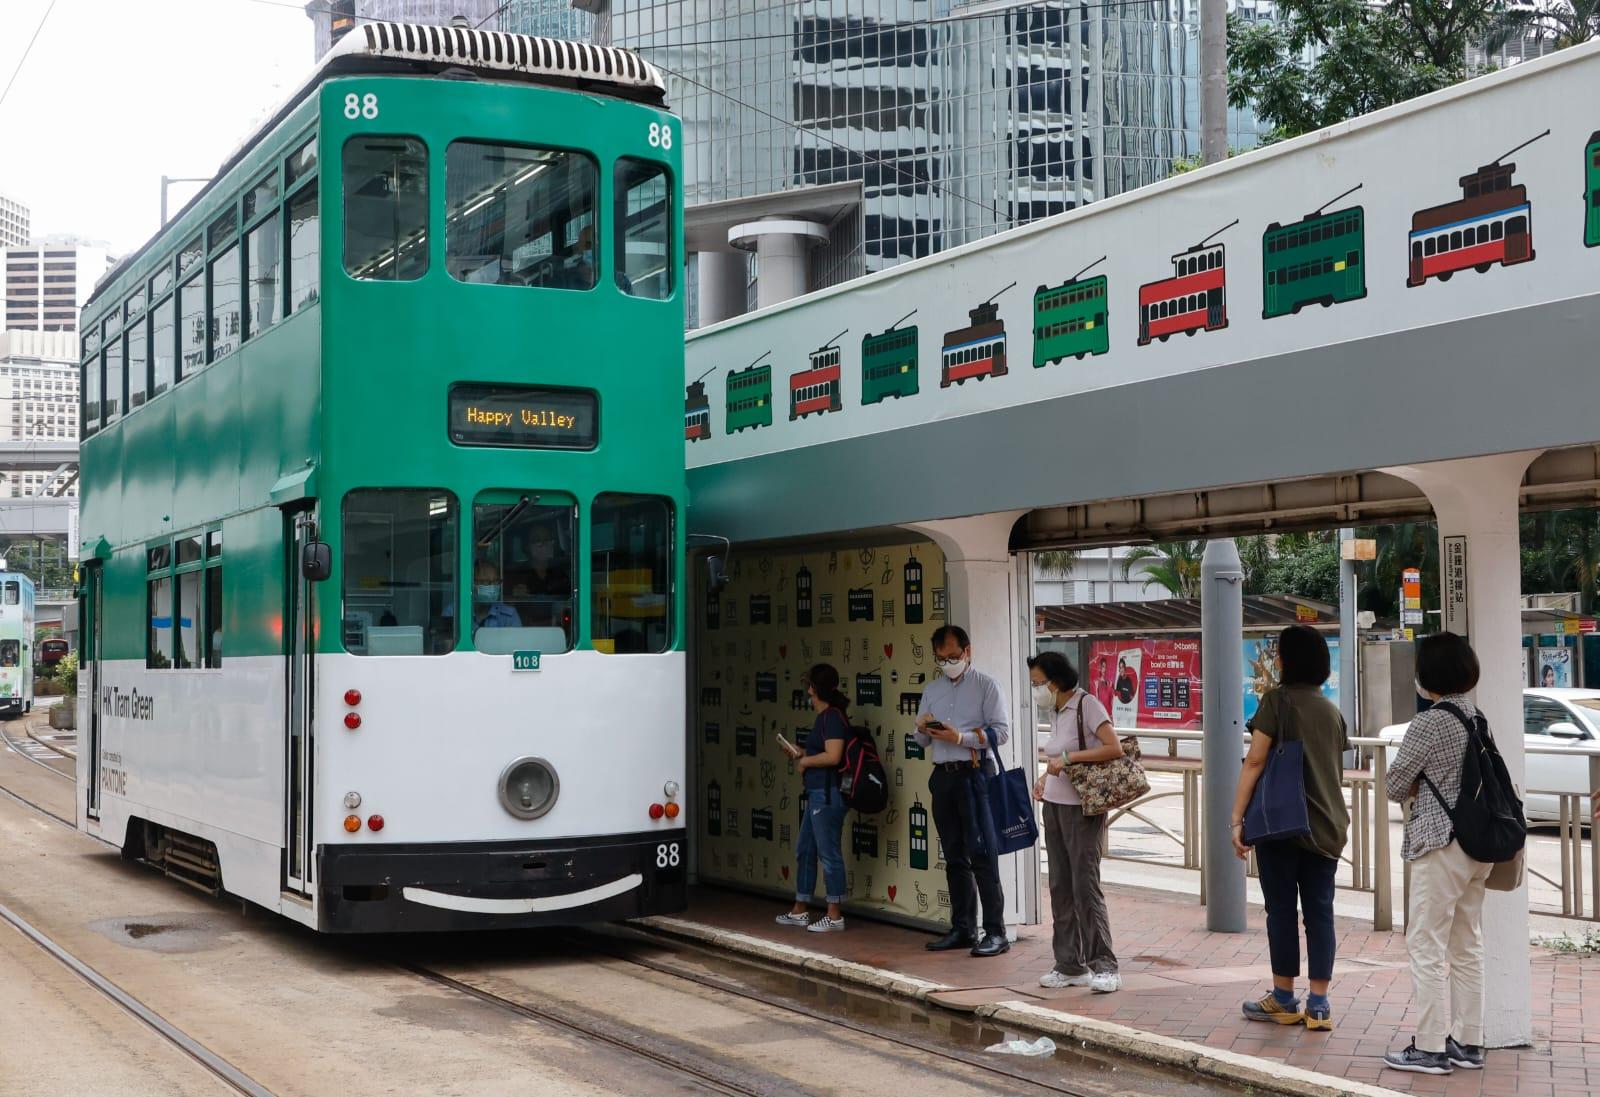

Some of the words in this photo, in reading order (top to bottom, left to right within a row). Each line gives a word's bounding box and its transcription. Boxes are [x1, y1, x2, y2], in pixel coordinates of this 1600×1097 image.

[344, 92, 379, 120] 88
[648, 122, 672, 150] 88
[466, 407, 513, 426] Happy
[521, 409, 576, 429] Valley
[515, 655, 539, 668] 108
[102, 685, 113, 716] HK
[114, 686, 130, 718] Tram
[131, 686, 154, 721] Green
[102, 766, 126, 796] PANTONE
[656, 843, 680, 868] 88
